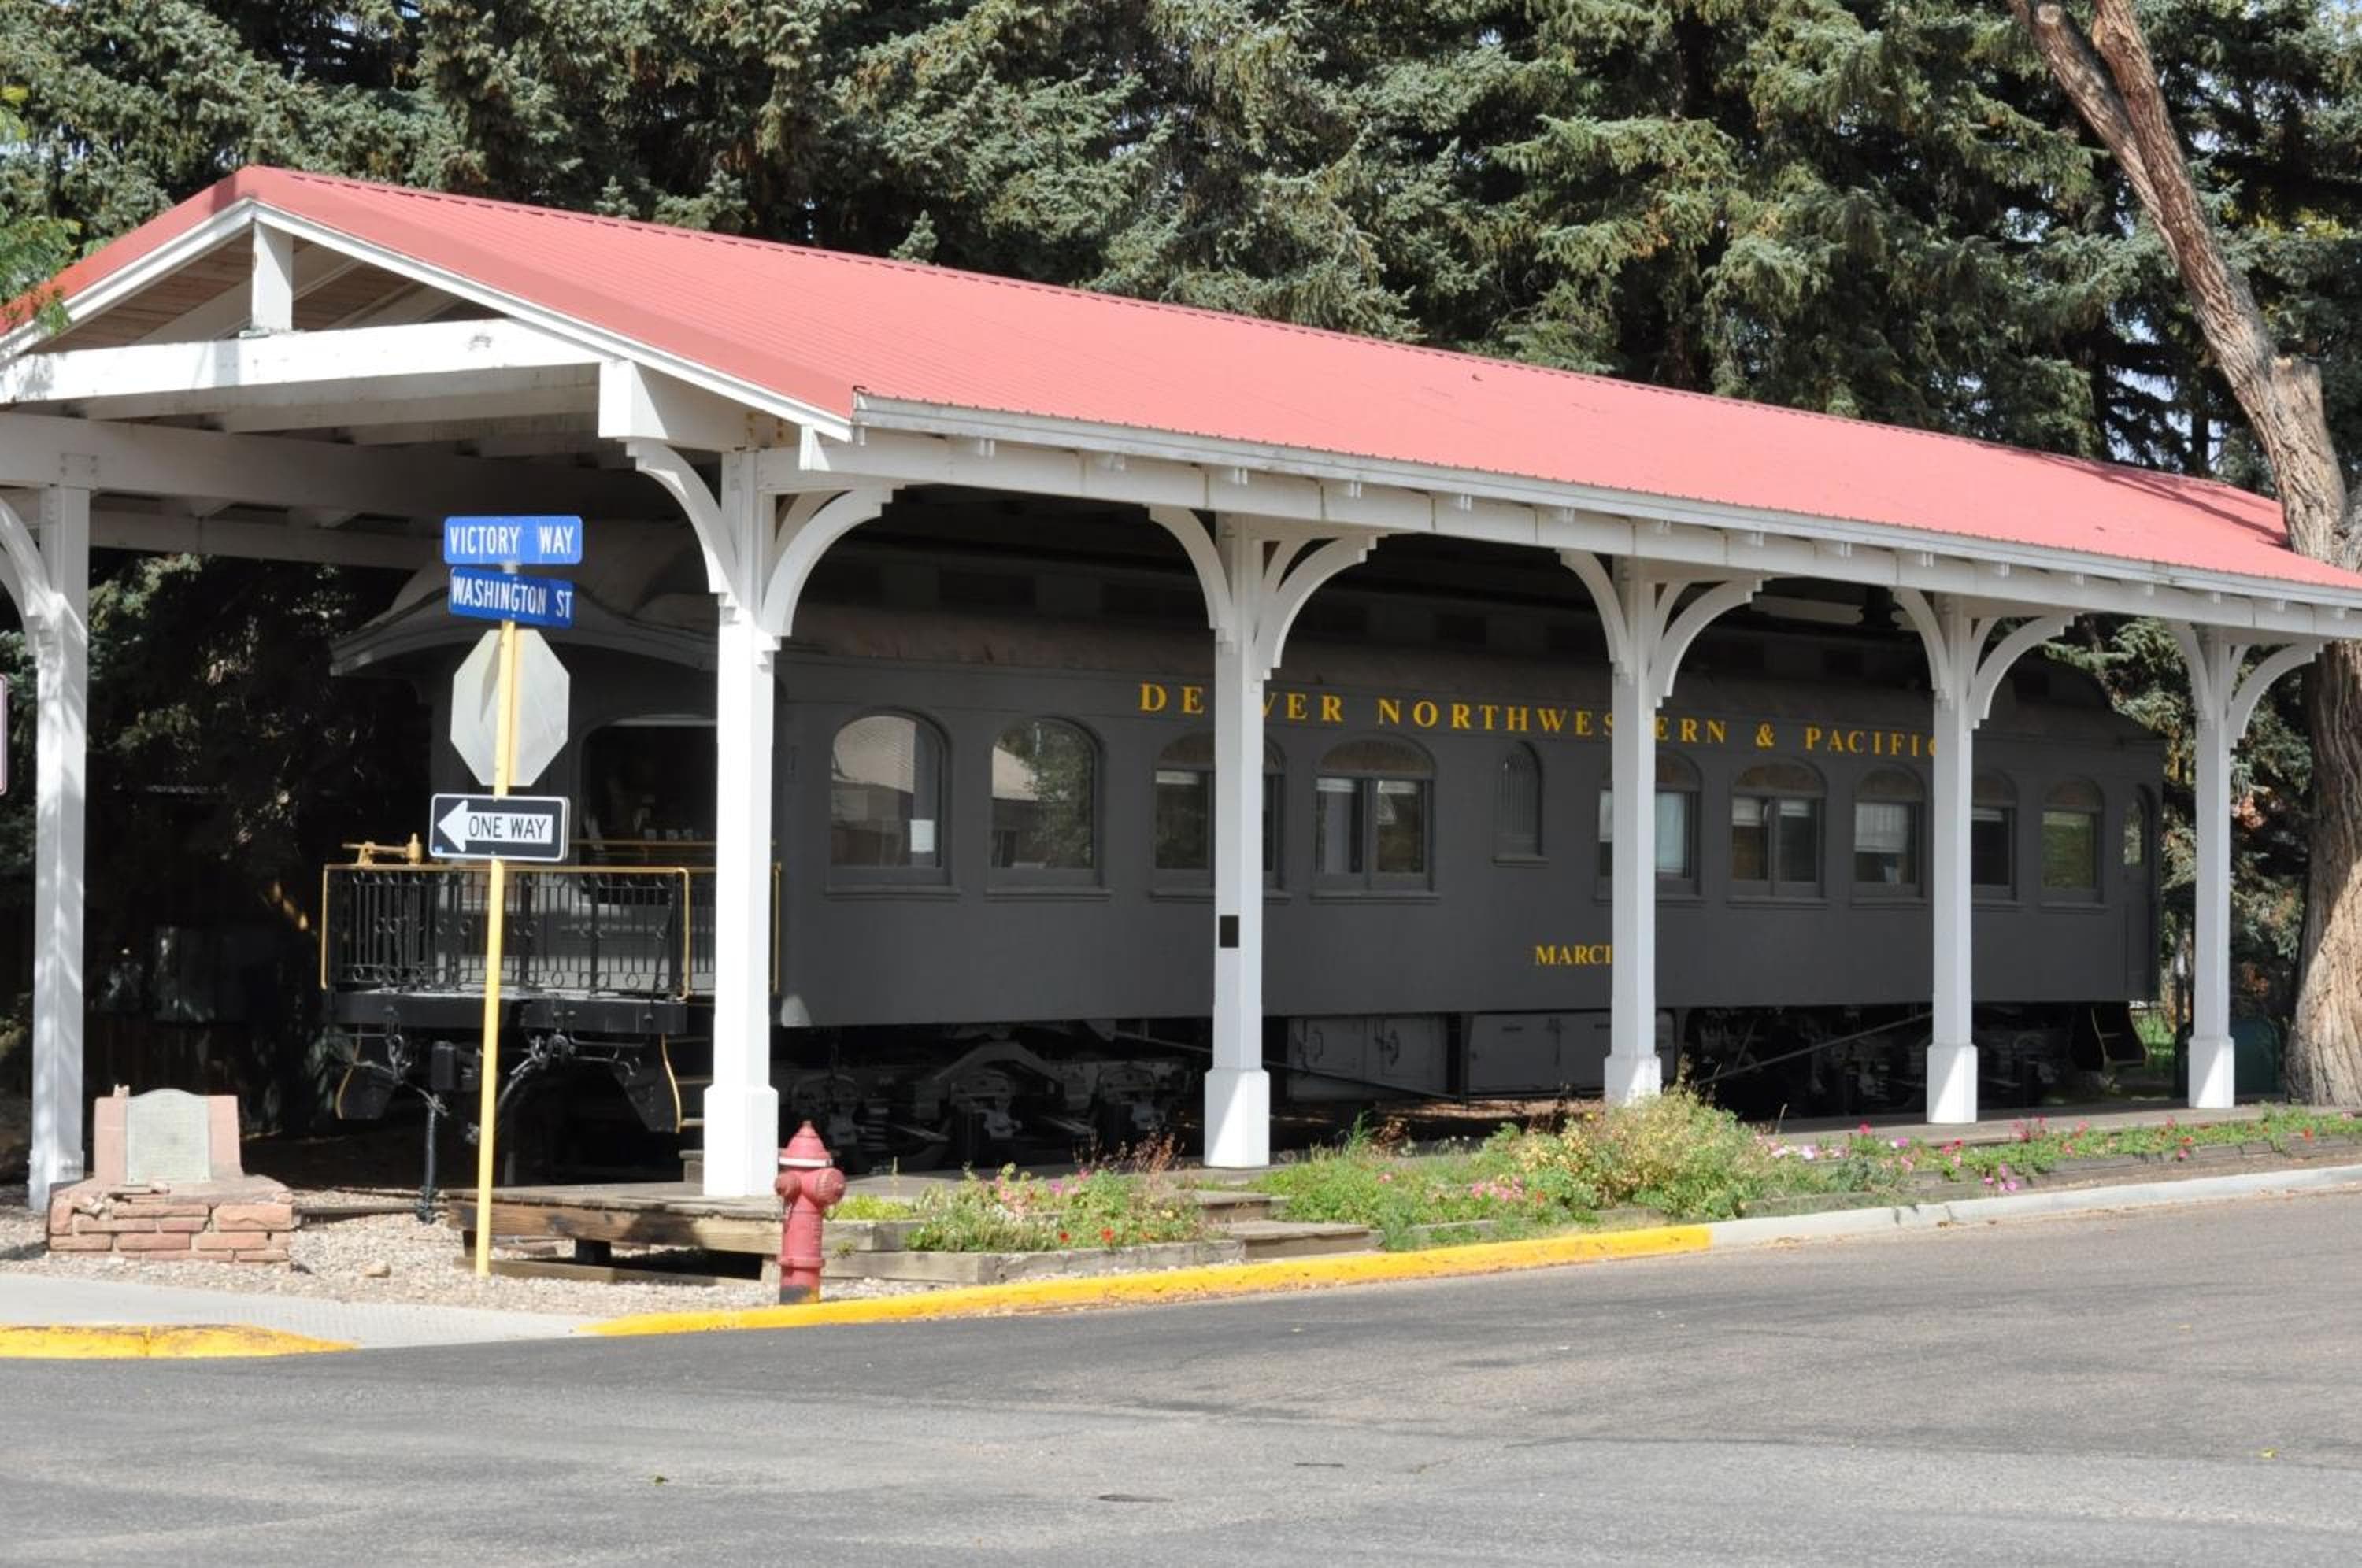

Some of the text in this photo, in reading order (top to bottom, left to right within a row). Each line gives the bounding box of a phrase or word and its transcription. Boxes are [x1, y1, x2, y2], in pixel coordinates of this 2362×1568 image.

[449, 526, 574, 554] VICTORY WAY
[451, 575, 573, 619] WASHINGTON ST
[1140, 682, 1343, 722] DEVER
[1376, 697, 1726, 743] NORTHWESERN
[1755, 723, 1774, 747] &
[468, 815, 547, 840] ONE WAY
[1535, 945, 1613, 966] MARCI
